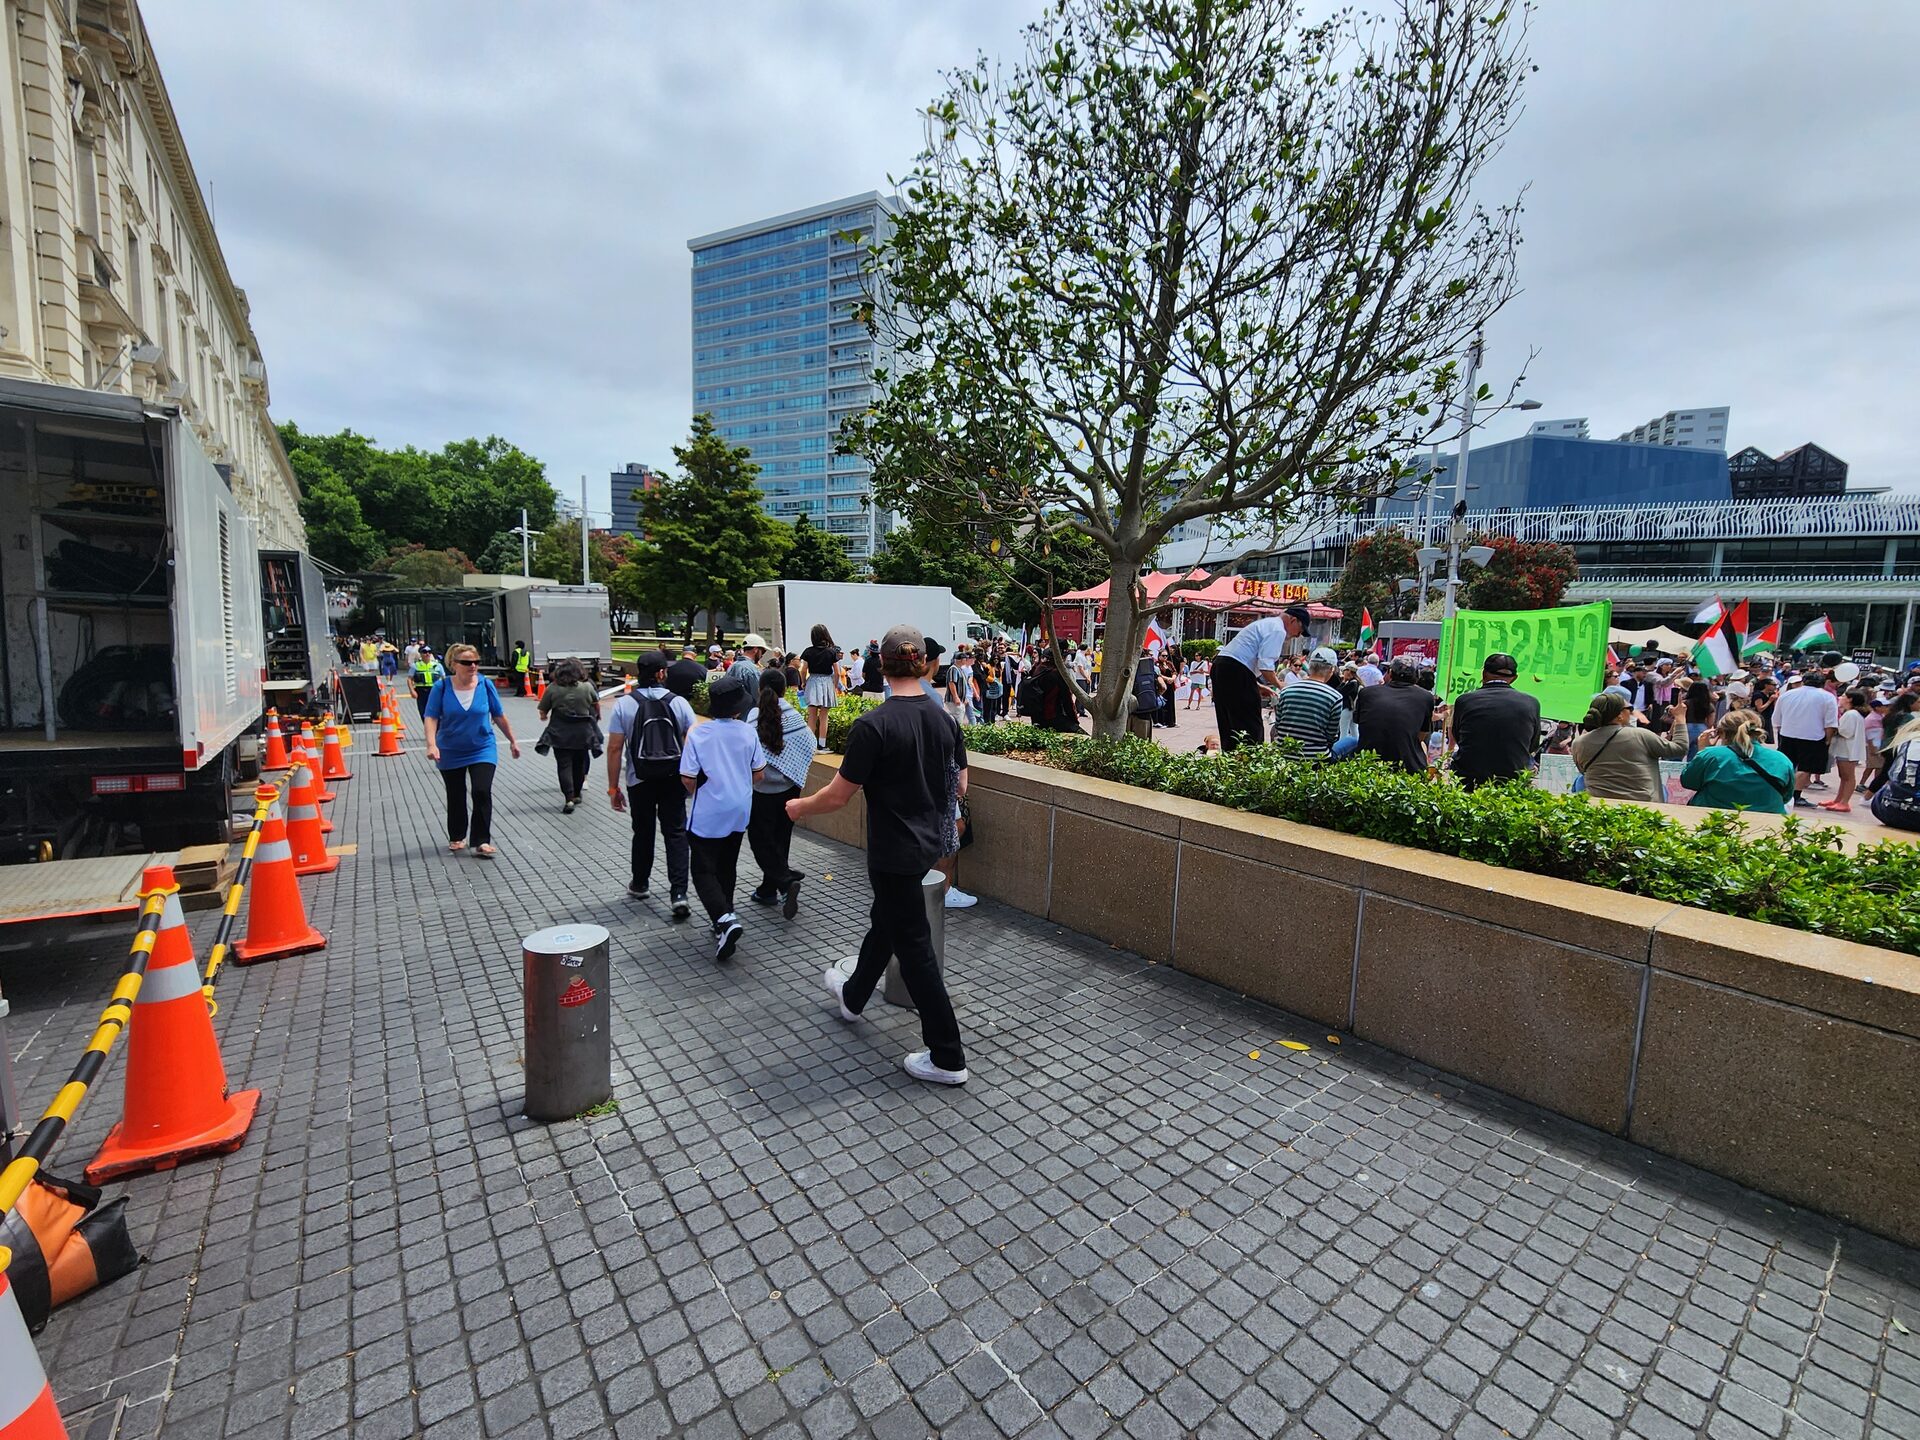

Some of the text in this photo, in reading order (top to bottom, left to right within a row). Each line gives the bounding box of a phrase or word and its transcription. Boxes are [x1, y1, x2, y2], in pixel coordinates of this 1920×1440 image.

[1234, 578, 1309, 600] CAFE & BAR
